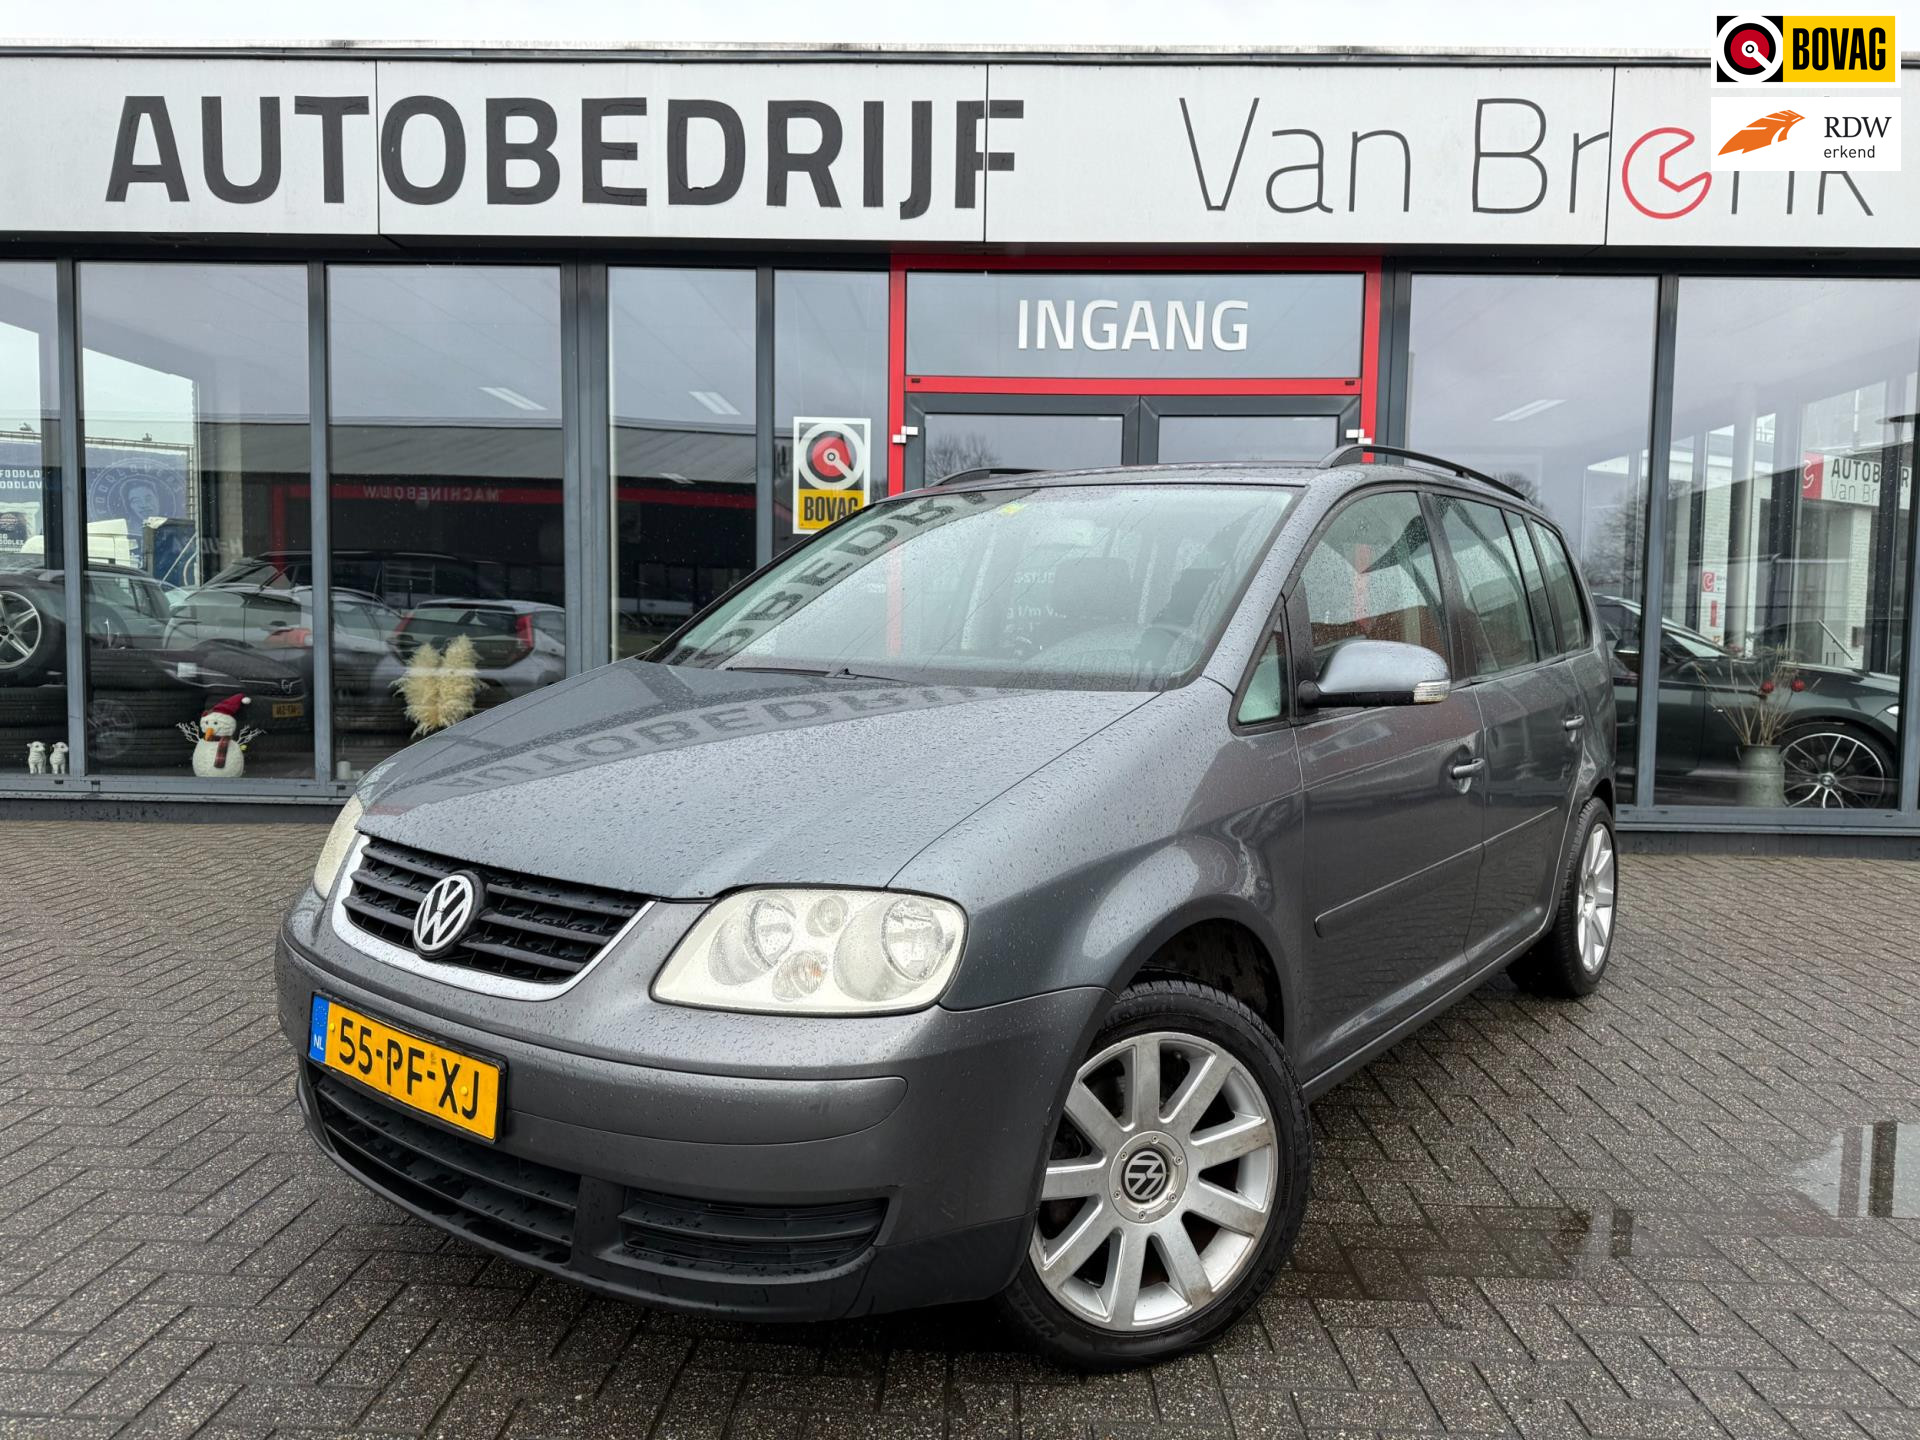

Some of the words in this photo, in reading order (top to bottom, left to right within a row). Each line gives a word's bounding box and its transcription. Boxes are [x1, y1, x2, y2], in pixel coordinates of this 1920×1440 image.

[105, 95, 1024, 220] AUTOBEDRIJF
[1179, 97, 1412, 214] Van
[1017, 299, 1249, 352] INGANG
[1831, 458, 1910, 488] AUTOBR
[313, 1033, 324, 1051] NL
[338, 1016, 480, 1121] 55-PF-XJ
